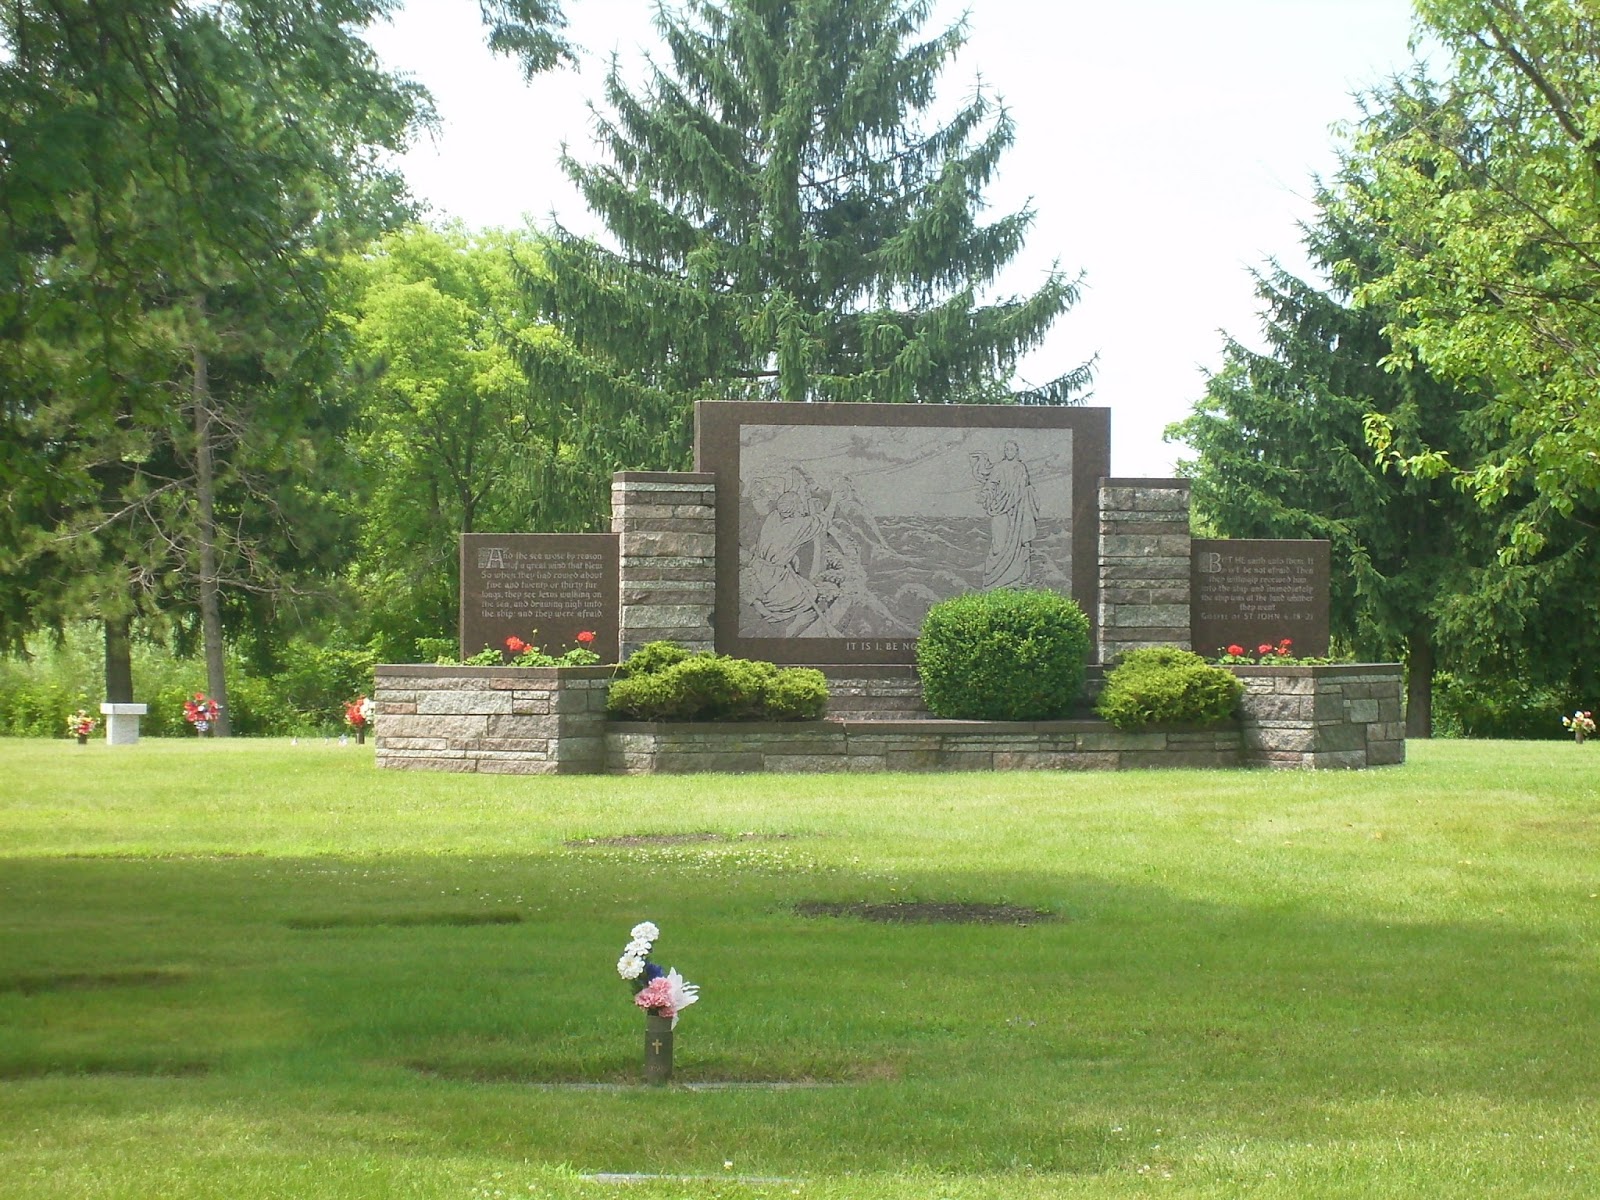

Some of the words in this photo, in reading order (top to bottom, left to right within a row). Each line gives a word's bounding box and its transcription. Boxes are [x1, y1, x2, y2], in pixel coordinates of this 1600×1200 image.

[516, 552, 528, 560] the
[526, 562, 547, 570] great
[481, 570, 492, 579] So
[494, 571, 516, 579] when
[518, 571, 535, 580] they
[537, 571, 552, 579] had
[553, 571, 578, 579] rowed
[580, 571, 603, 579] about
[486, 581, 502, 589] five
[504, 581, 519, 589] and
[521, 581, 548, 590] twenty
[561, 581, 583, 590] thirty
[505, 590, 522, 600] they
[538, 590, 558, 598] Jesus
[560, 590, 590, 600] walking
[481, 600, 494, 608] the
[513, 600, 529, 608] and
[530, 600, 563, 609] drawing
[565, 600, 582, 610] nigh
[535, 610, 553, 618] they
[846, 642, 856, 650] IT
[861, 642, 871, 650] IS
[885, 642, 898, 650] BE
[902, 642, 917, 650] NO
